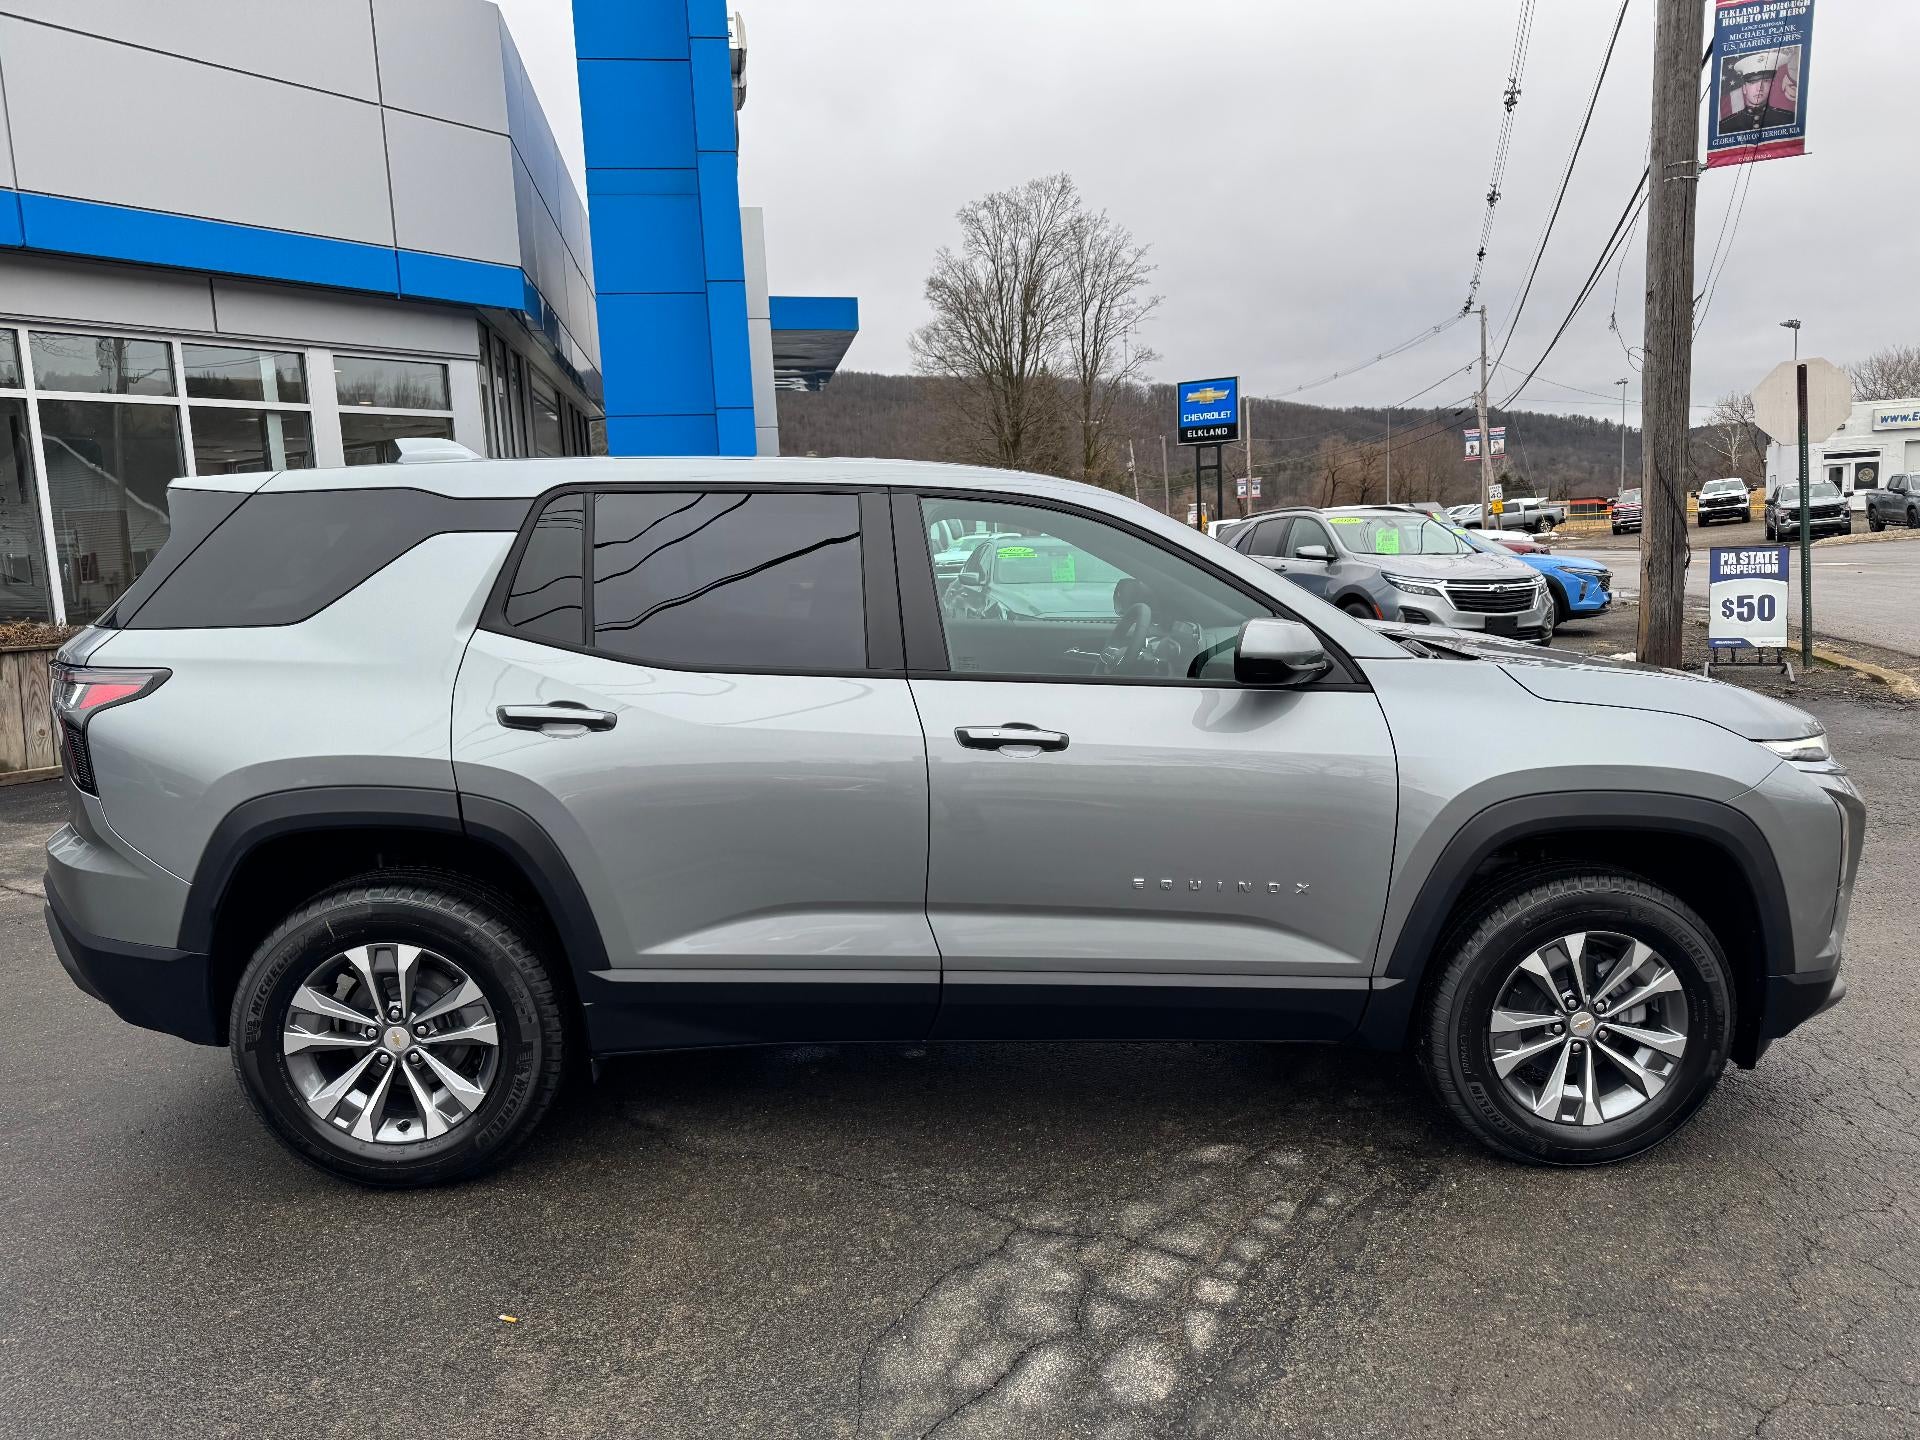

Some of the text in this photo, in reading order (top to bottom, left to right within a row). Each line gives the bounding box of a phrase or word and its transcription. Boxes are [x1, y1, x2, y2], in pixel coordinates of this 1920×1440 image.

[1719, 0, 1811, 19] ELKLAND BOROUGH
[1722, 7, 1806, 26] HOMETOWN HERO
[1729, 25, 1796, 40] MICHAEL PLANK
[1723, 33, 1801, 51] U.S. MARINE CORPS
[1712, 136, 1736, 145] GLOBAL
[1183, 410, 1231, 422] CHEVROLET
[1880, 411, 1920, 423] www.E
[1187, 427, 1228, 438] ELKLAND
[1720, 551, 1779, 565] PA STATE
[1720, 564, 1779, 575] INSPECTION
[1721, 594, 1776, 622] $50
[1132, 878, 1310, 894] EQUINOX
